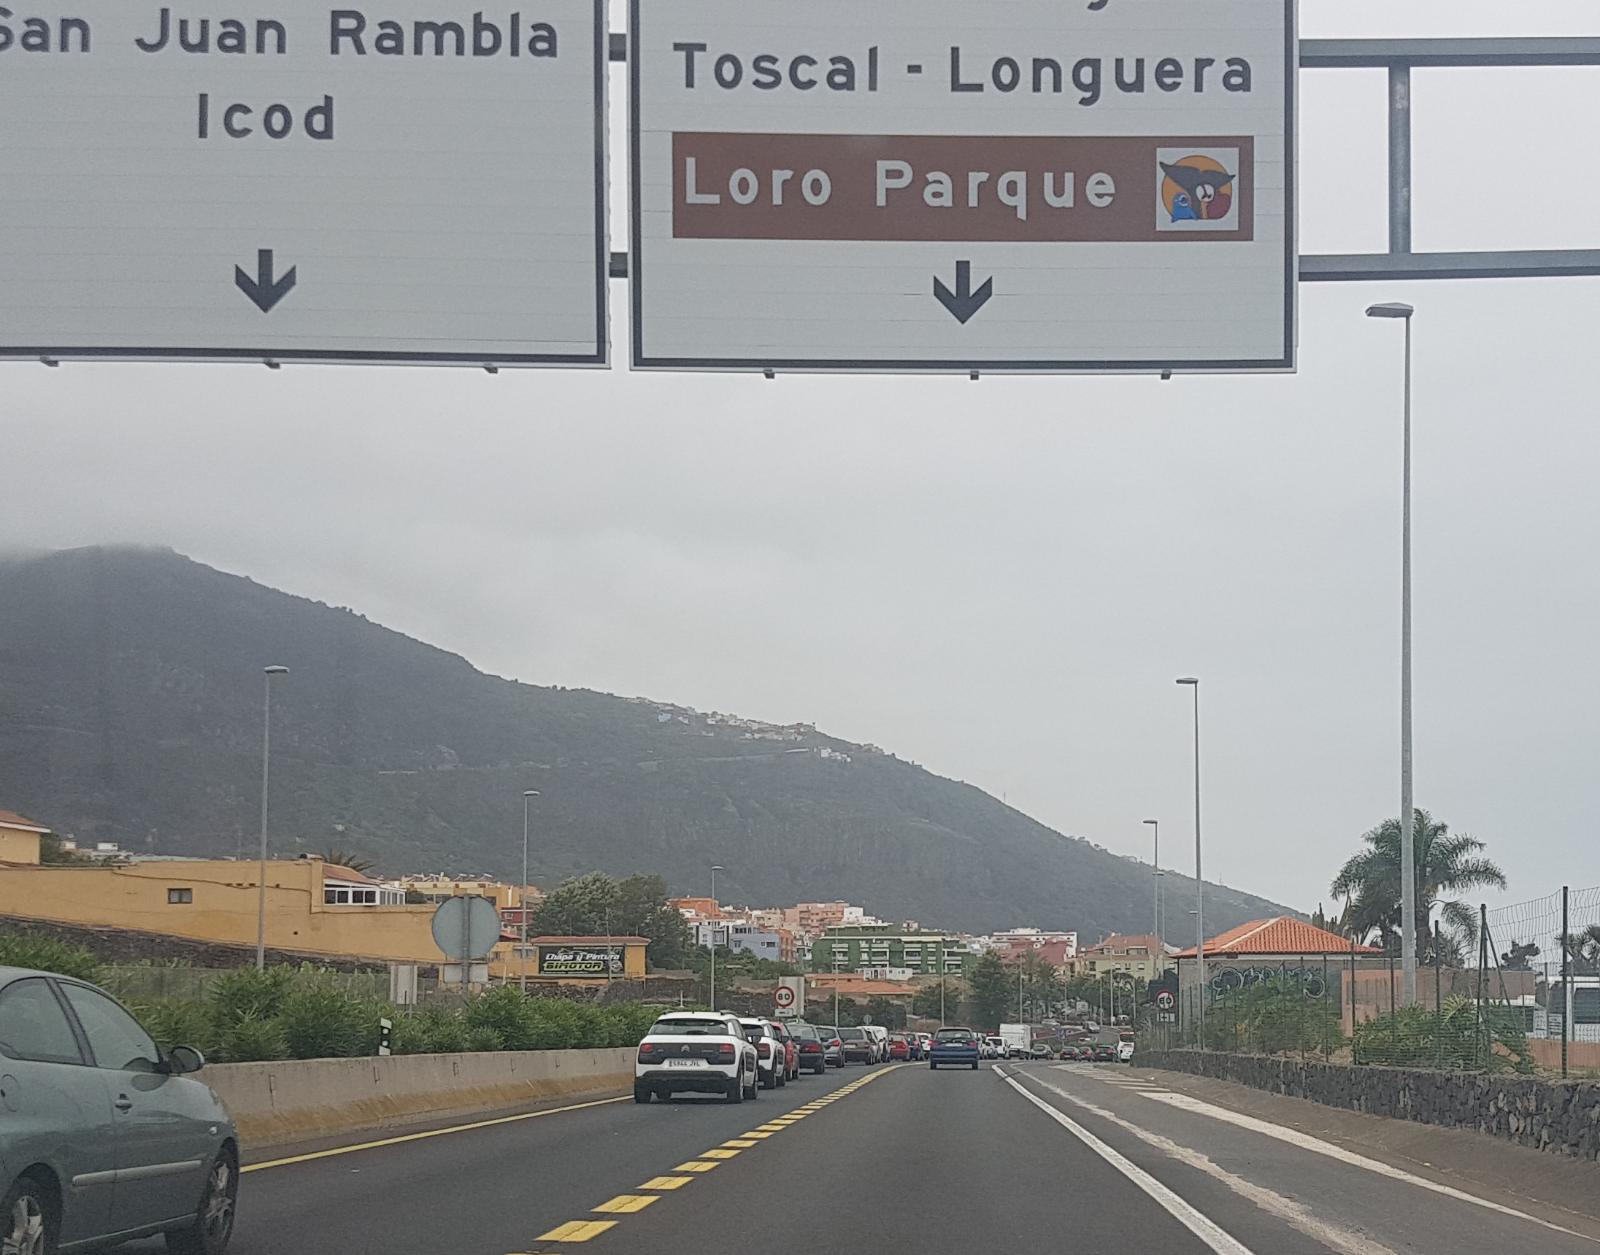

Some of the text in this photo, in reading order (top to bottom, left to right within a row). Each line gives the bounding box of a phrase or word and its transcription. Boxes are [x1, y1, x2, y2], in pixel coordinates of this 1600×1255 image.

[134, 7, 287, 55] Juan
[330, 10, 558, 58] Rambla
[672, 43, 878, 92] Toscal
[950, 46, 1252, 107] Longuera
[198, 93, 334, 140] Icod
[686, 157, 1116, 221] Loro Parque
